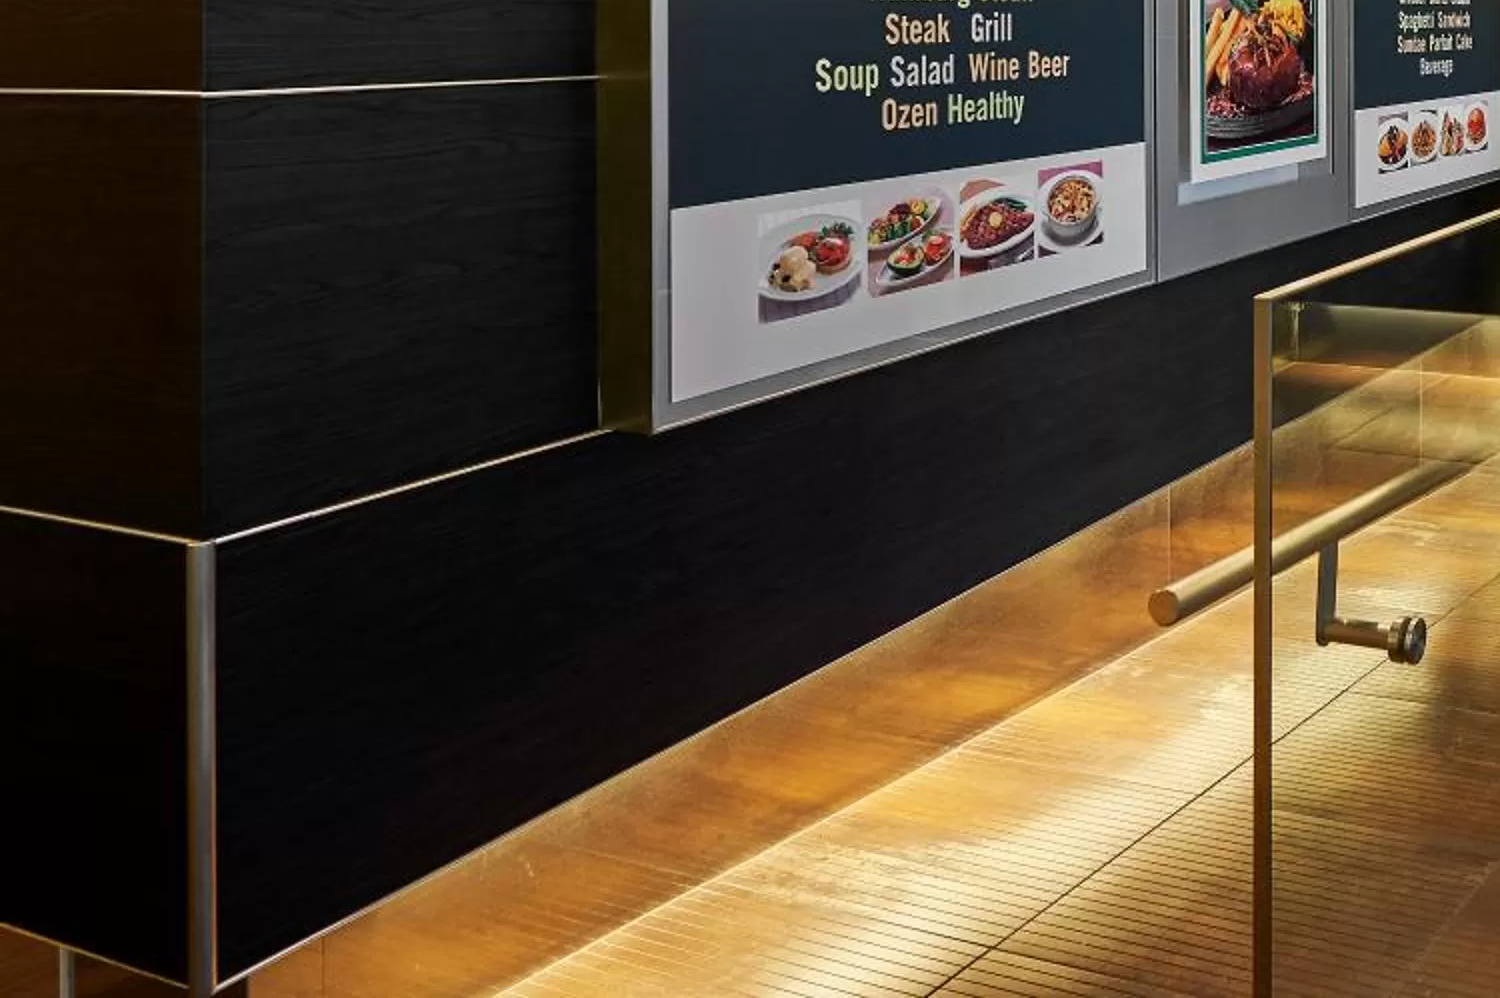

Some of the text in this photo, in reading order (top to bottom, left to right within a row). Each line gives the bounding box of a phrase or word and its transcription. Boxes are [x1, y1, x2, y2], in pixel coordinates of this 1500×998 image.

[884, 11, 1014, 45] Steak Grill
[814, 50, 1071, 97] Soup Salad Wine Beer
[880, 89, 1025, 131] Ozen Healthy
